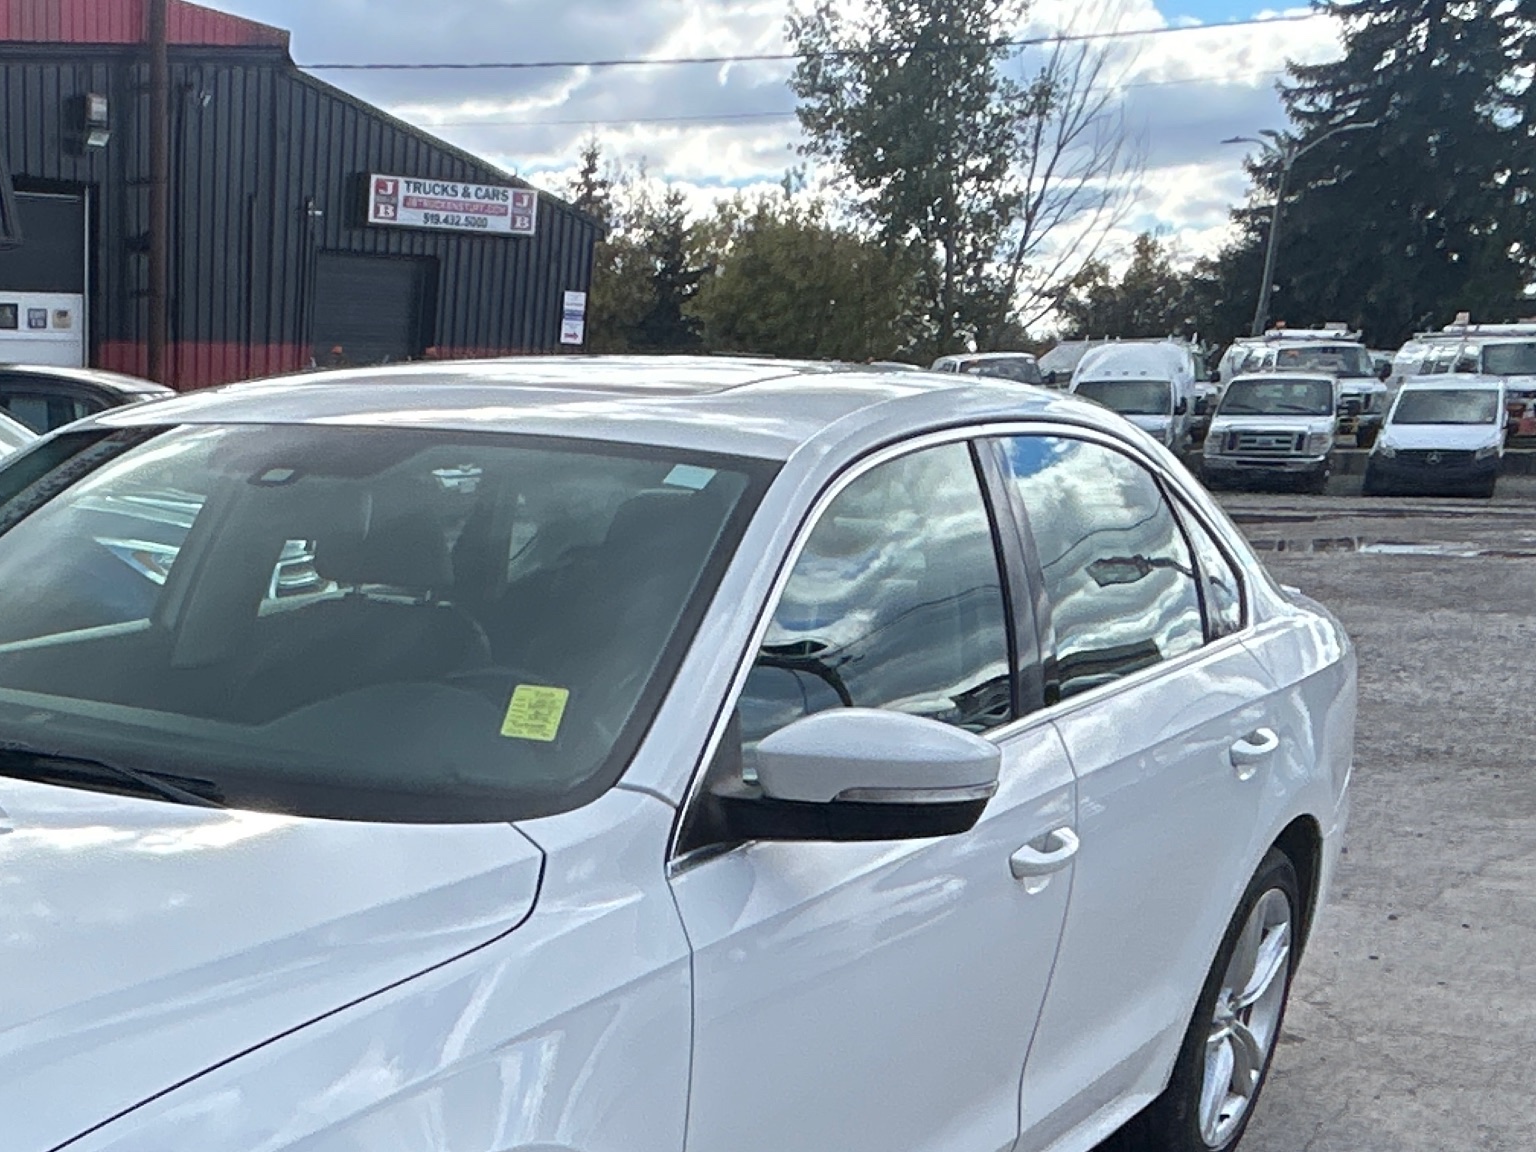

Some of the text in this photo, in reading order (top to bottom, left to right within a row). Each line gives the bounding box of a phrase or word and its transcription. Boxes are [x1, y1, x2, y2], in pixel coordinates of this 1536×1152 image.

[404, 180, 509, 202] TRUCKS & CARS
